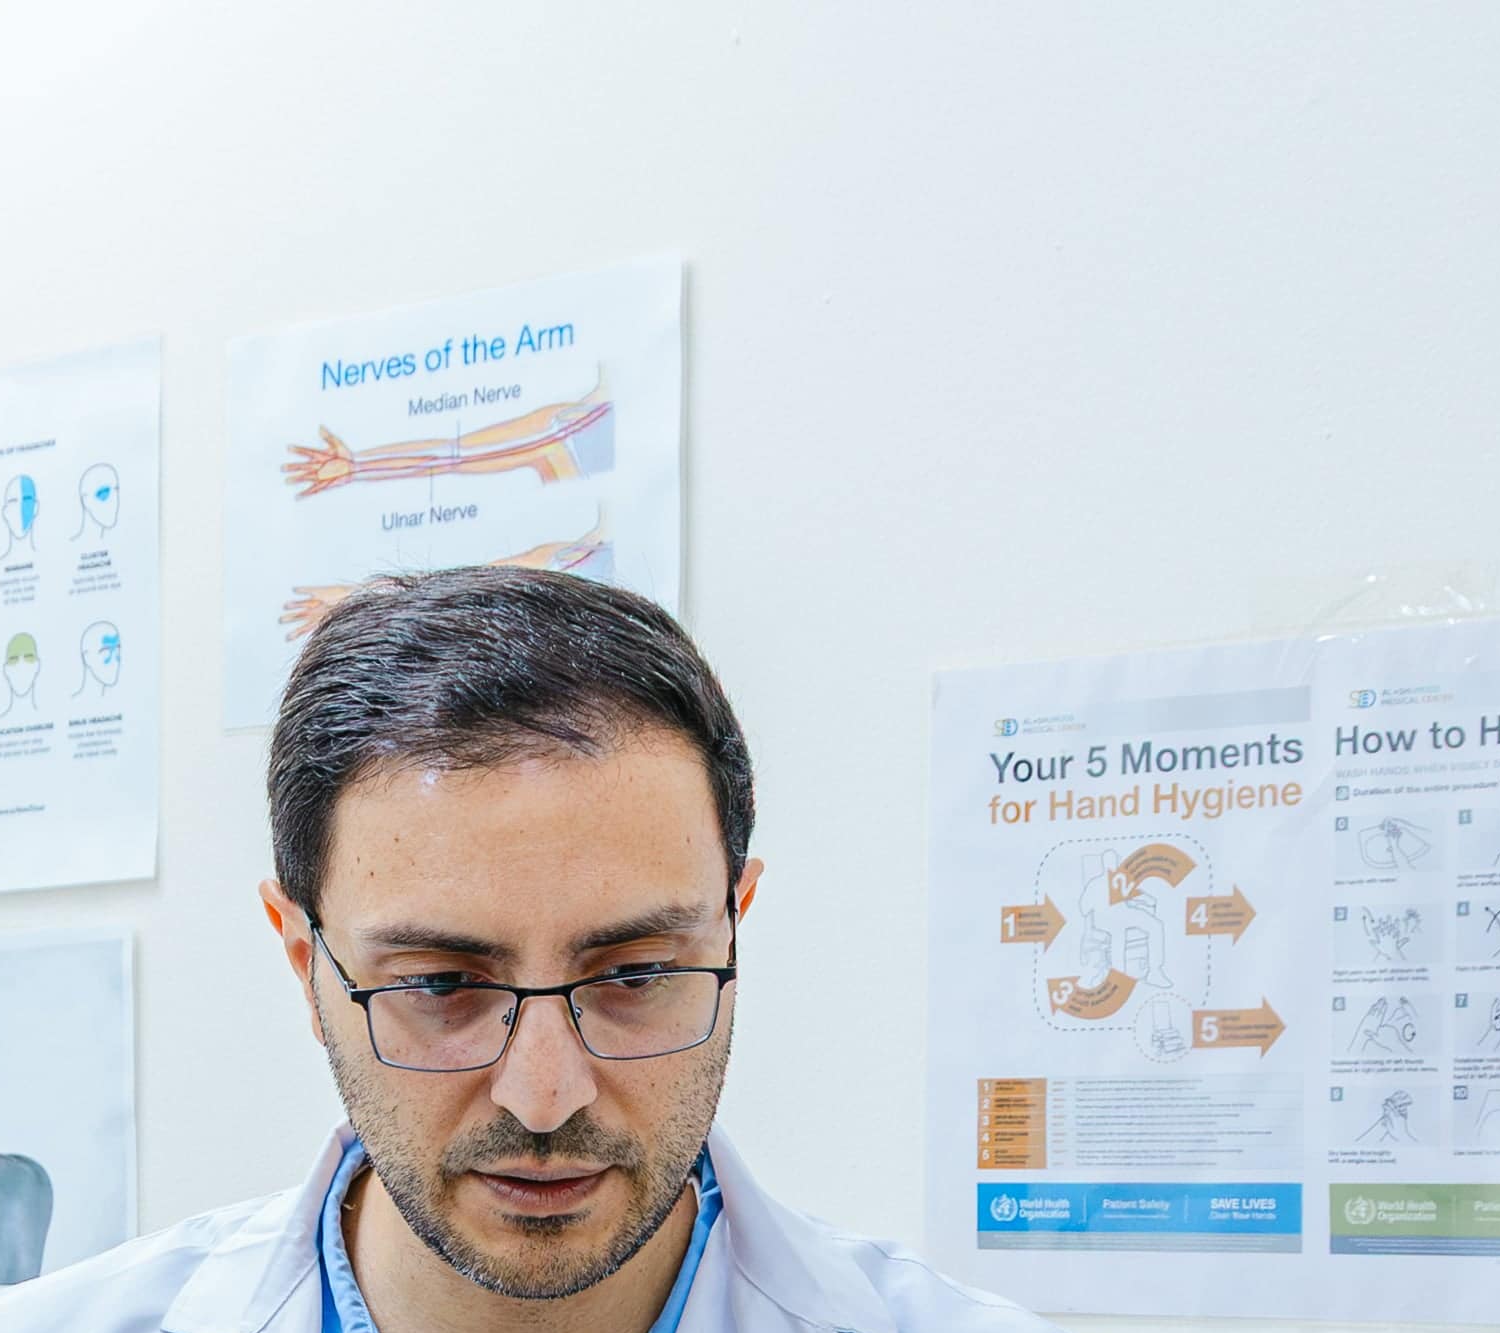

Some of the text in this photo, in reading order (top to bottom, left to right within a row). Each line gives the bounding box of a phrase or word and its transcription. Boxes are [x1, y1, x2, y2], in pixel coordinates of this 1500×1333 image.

[321, 322, 575, 390] Nerves of the Arm
[408, 383, 521, 417] Median Nerve
[381, 502, 478, 531] Ulnar Nerve
[1335, 726, 1417, 757] How
[1429, 721, 1466, 750] to
[990, 733, 1303, 784] Your 5 Moments
[1370, 765, 1410, 777] HANDS
[989, 780, 1303, 825] for Hand Hygiene
[1111, 873, 1136, 898] 2
[1003, 912, 1017, 937] 1
[1191, 903, 1208, 929] 4
[1052, 980, 1074, 1005] 3
[1201, 1016, 1219, 1043] 5
[1103, 1198, 1171, 1211] Patient Safety
[1210, 1198, 1276, 1210] SAVE LIVES
